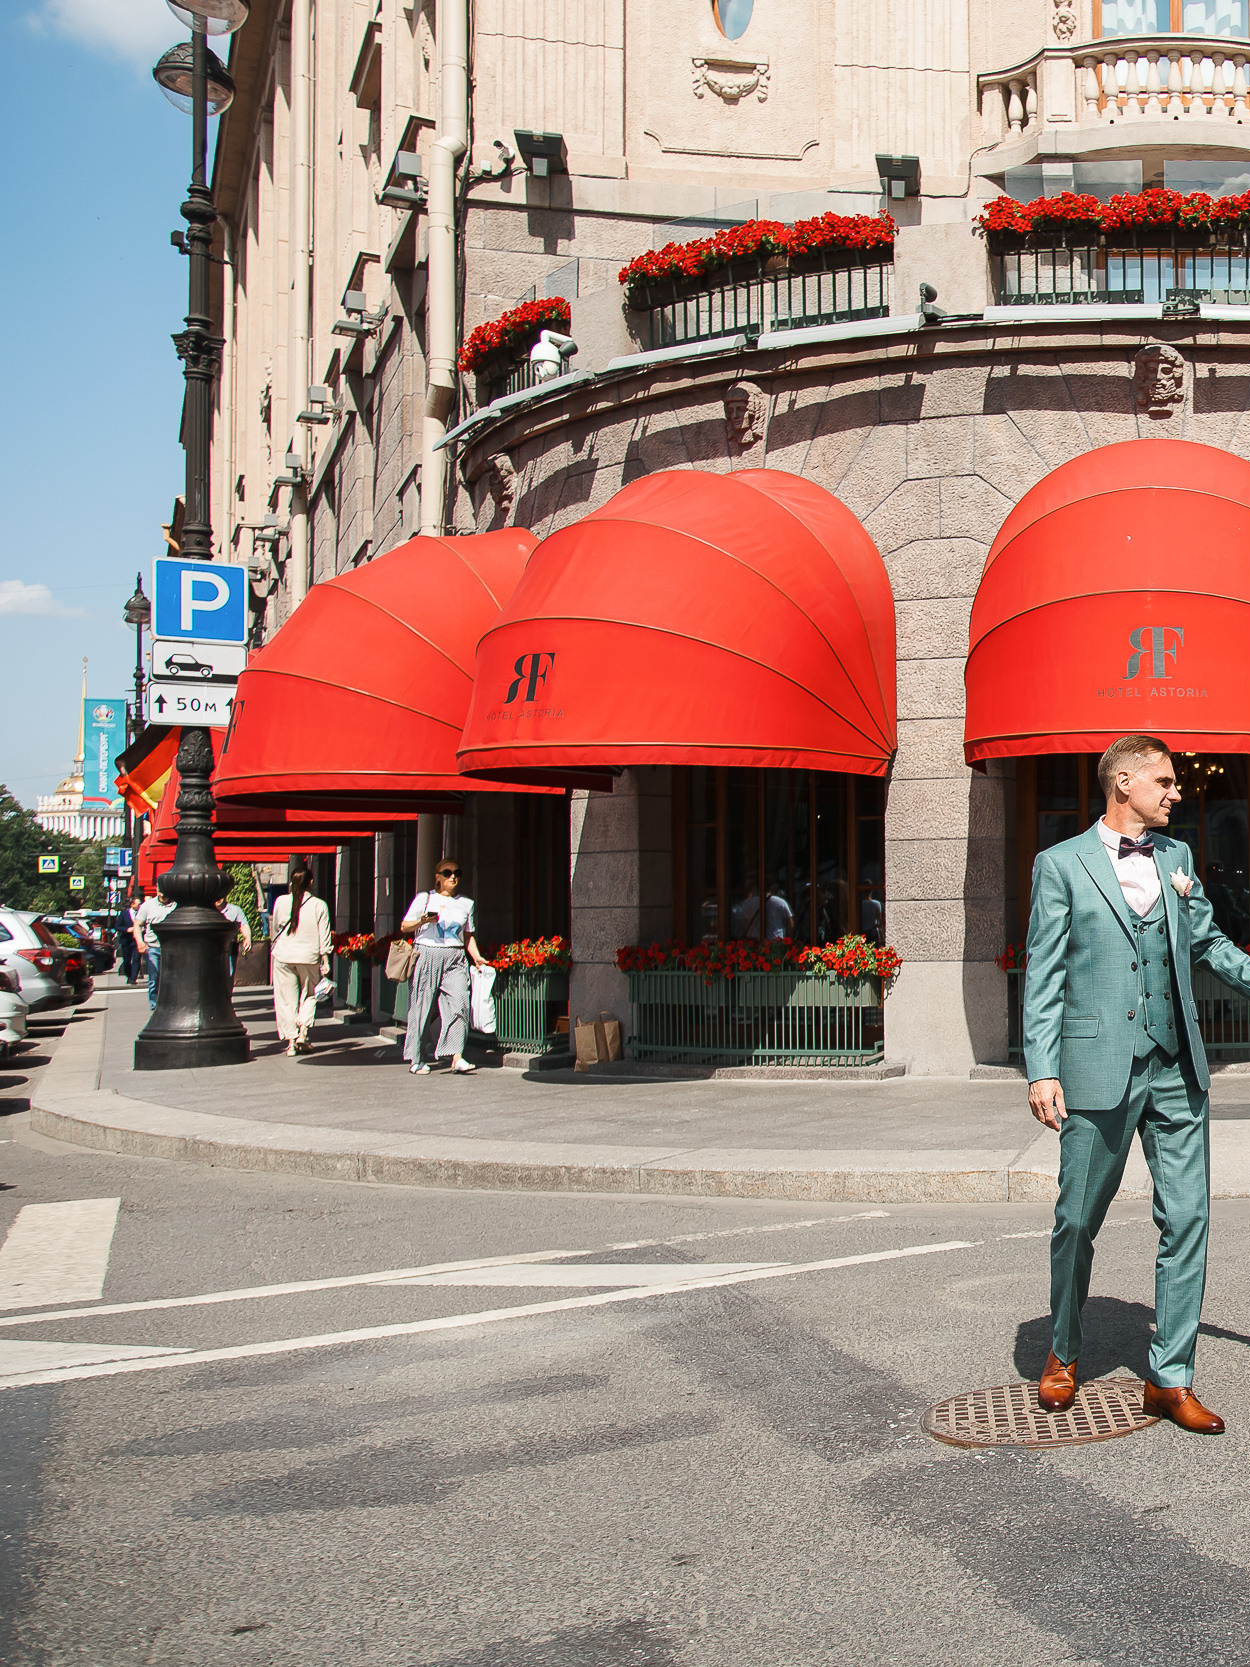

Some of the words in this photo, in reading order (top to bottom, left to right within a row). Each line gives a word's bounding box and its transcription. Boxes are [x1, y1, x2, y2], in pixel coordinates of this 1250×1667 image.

[180, 570, 230, 631] P
[1097, 687, 1141, 698] HOTEL
[1150, 687, 1208, 698] ASTORIA
[486, 711, 514, 721] HOTEL
[519, 708, 564, 719] ASTORIA
